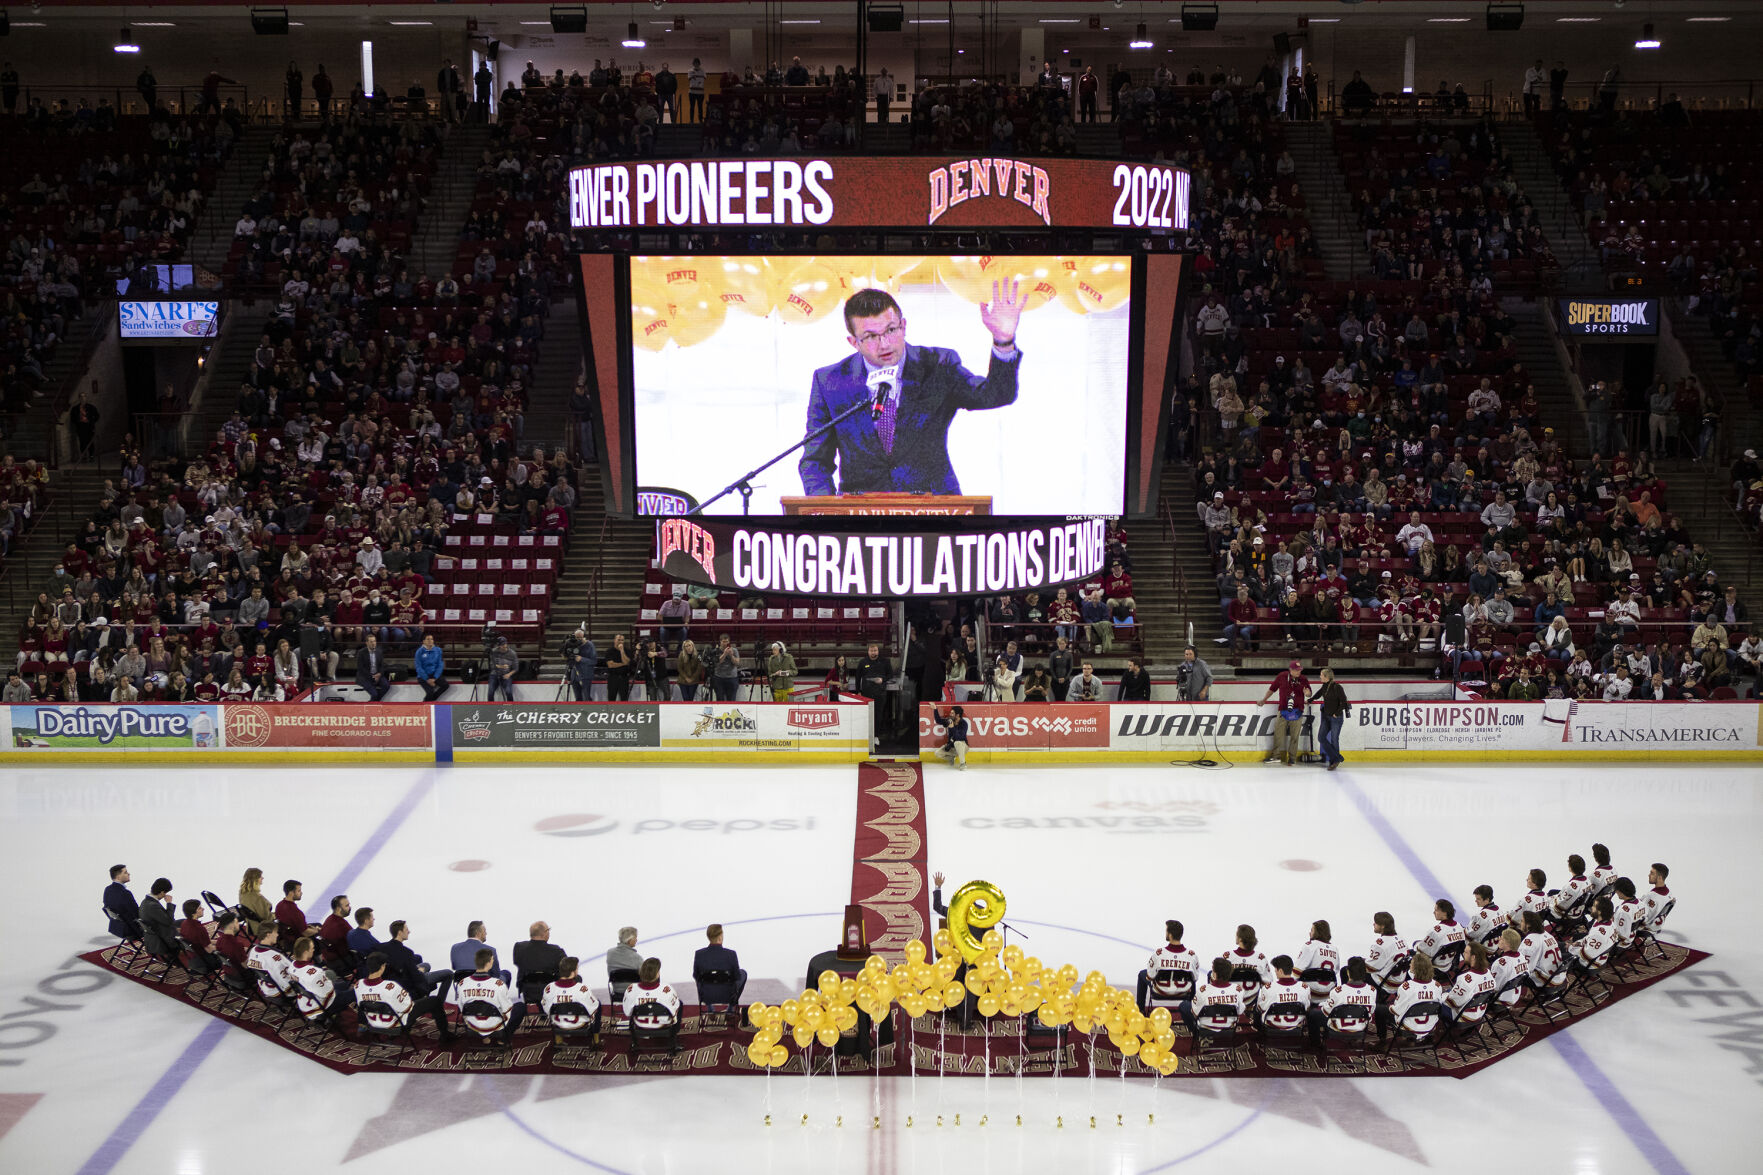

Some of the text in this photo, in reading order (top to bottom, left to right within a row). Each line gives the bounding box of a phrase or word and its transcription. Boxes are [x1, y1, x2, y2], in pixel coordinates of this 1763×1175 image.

[637, 160, 834, 225] PIONEERS
[929, 158, 1051, 226] DENVER
[1113, 164, 1173, 228] 2022
[666, 270, 697, 284] DENVER
[120, 302, 218, 321] SNARF'S
[1568, 301, 1648, 325] SUPERBOOK
[121, 321, 182, 330] Sandwiches
[1585, 324, 1629, 333] SPORTS
[732, 529, 1045, 595] CONGRATULATIONS
[274, 715, 428, 727] BRECKENRIDGE BREWERY
[496, 710, 656, 724] The CHERRY CRICKET
[794, 711, 832, 728] bryant
[1074, 717, 1097, 726] credit
[714, 717, 754, 730] ROCK
[312, 729, 392, 737] FINE COLORADO ALES
[515, 731, 543, 739] DENVER'S
[544, 731, 573, 739] FAVORITE
[574, 731, 599, 739] BURGER
[605, 731, 622, 739] SINCE
[623, 731, 638, 739] 1945
[1438, 735, 1474, 743] Changing
[1575, 725, 1741, 743] TRANSAMERICA
[631, 815, 817, 835] pepsi
[959, 813, 1208, 831] canvas
[1423, 936, 1436, 947] 16
[1588, 938, 1602, 950] 28
[1369, 949, 1380, 960] 32
[1160, 959, 1191, 970] KRENZEN
[462, 988, 495, 998] TUOMISTO
[1418, 990, 1434, 1000] OZAR
[1452, 984, 1467, 997] 25
[556, 994, 573, 1003] KING
[1208, 994, 1238, 1005] BEHRENS
[1279, 993, 1298, 1002] RIZZO
[1346, 995, 1371, 1005] CAPONI
